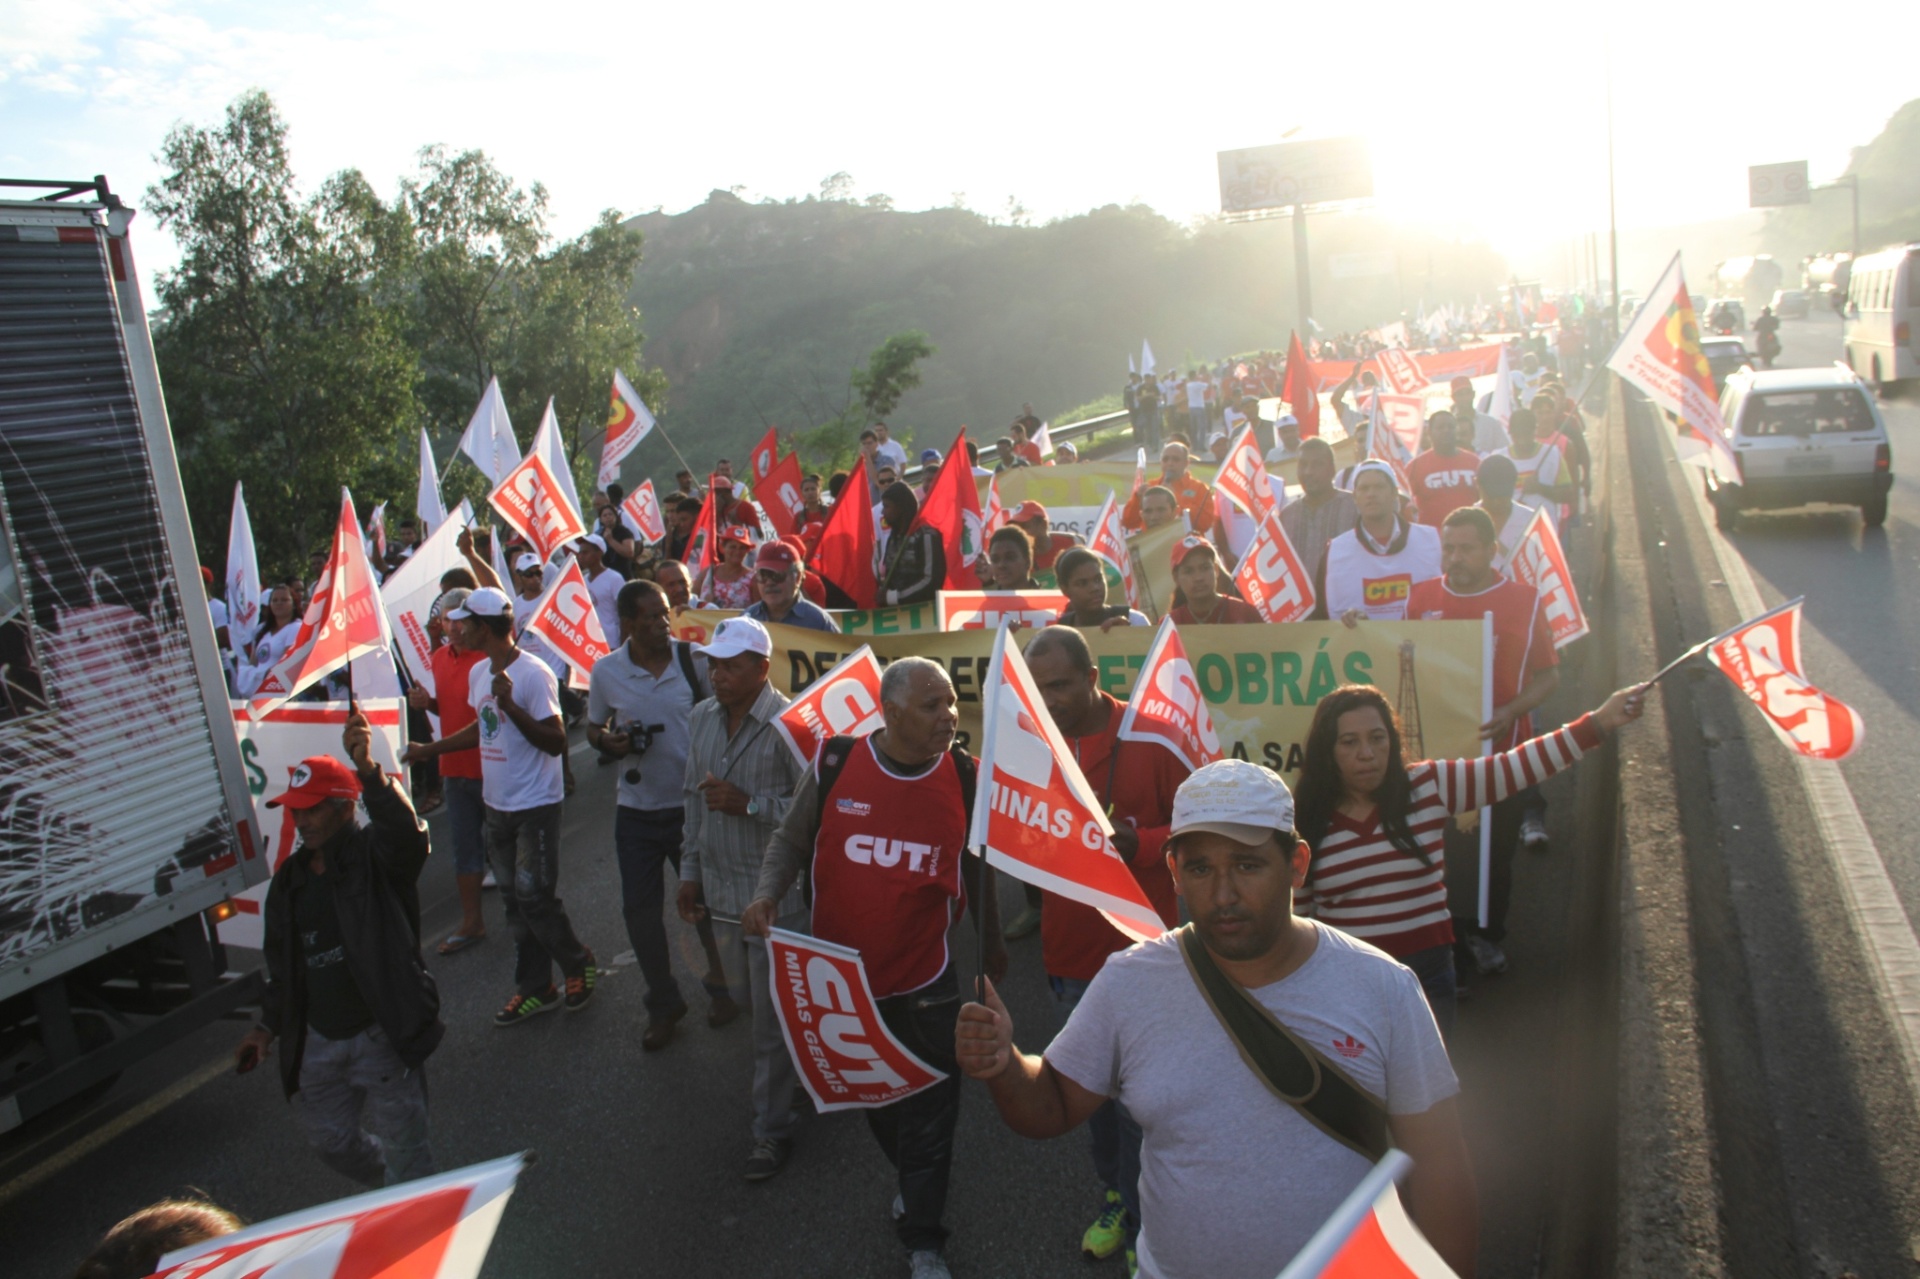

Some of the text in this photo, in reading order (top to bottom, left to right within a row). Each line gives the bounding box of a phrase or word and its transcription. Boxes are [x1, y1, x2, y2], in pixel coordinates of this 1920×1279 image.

[502, 486, 533, 518] MINAS
[514, 467, 569, 537] CUT
[1517, 553, 1534, 586] MINA
[1365, 580, 1409, 600] CTB
[543, 608, 584, 647] MINAS
[841, 601, 937, 635] PET
[797, 702, 827, 741] MIN
[1143, 698, 1199, 751] MINAS
[844, 834, 931, 872] CUT
[929, 845, 941, 877] BRASIL
[785, 951, 848, 1095] MINAS GERAIS
[806, 956, 909, 1089] CUT
[858, 1085, 917, 1101] BRASIL
